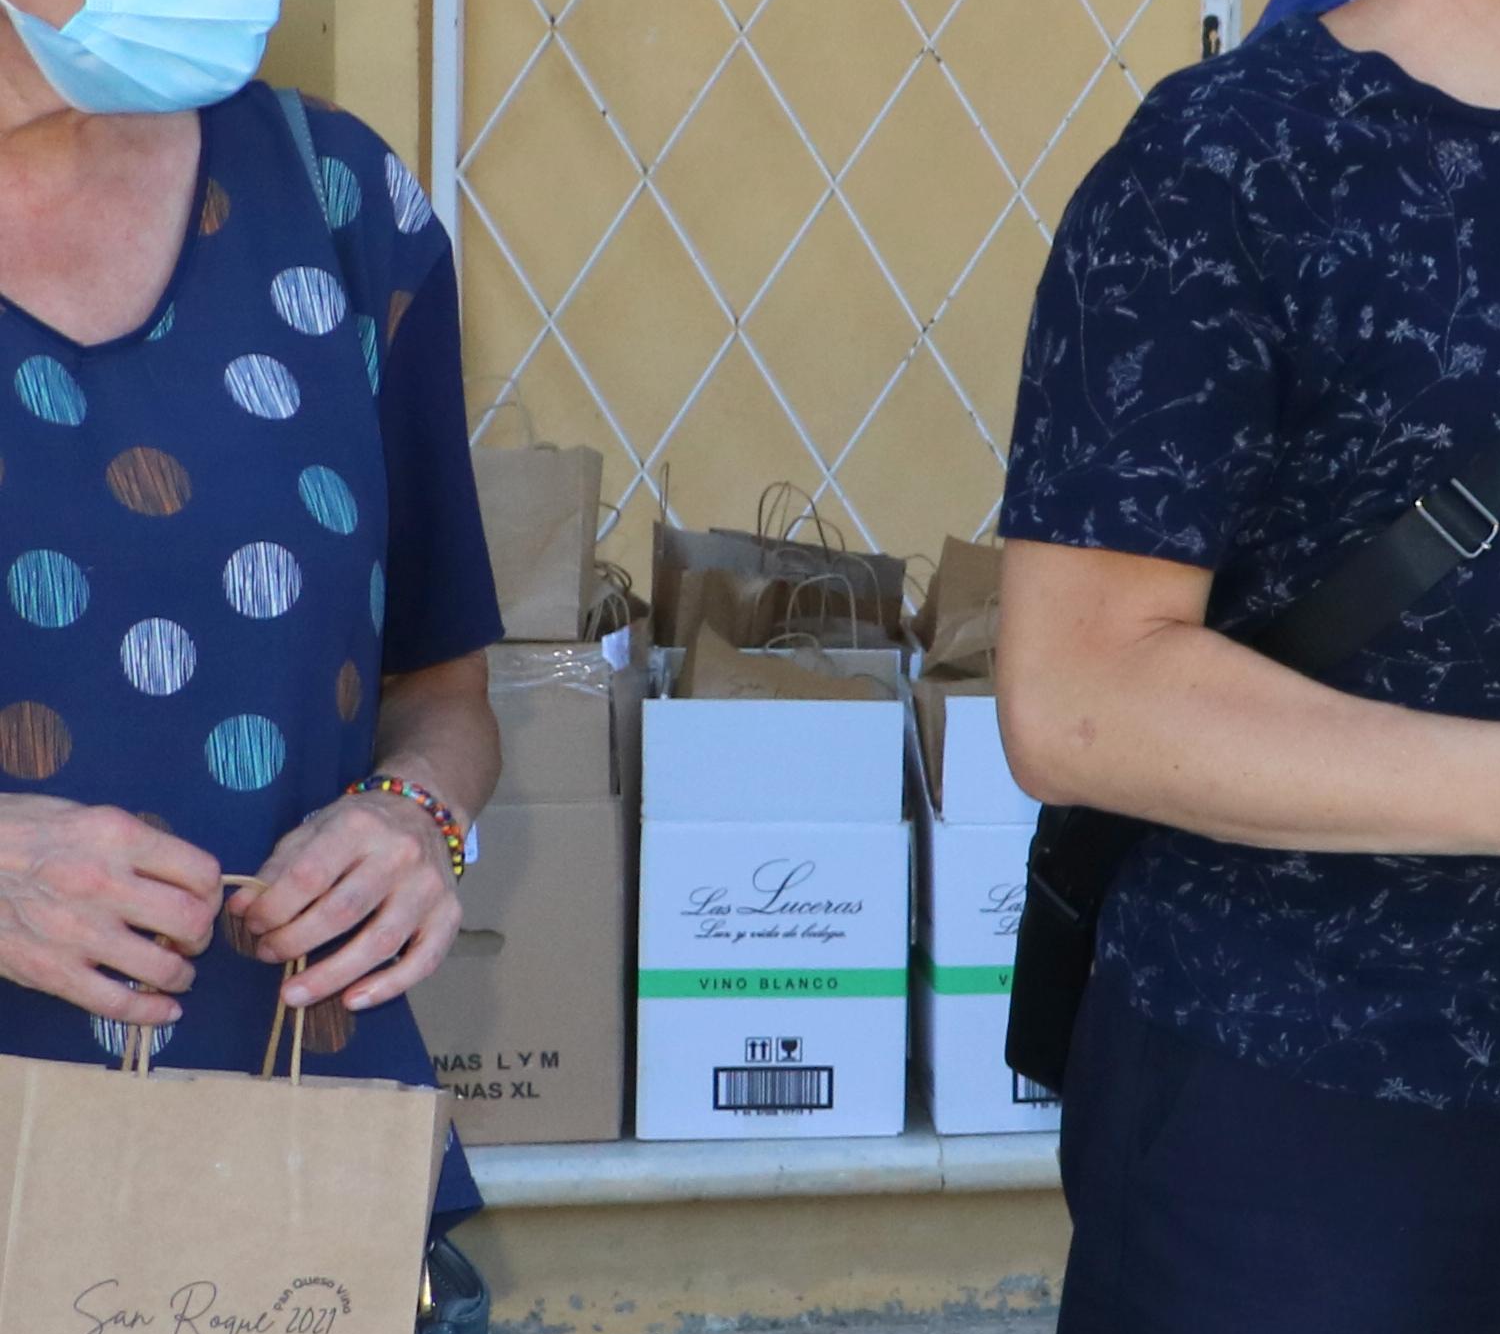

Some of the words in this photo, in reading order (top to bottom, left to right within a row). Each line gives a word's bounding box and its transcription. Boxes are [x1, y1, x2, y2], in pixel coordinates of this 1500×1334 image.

[680, 885, 732, 917] Las
[737, 858, 864, 916] Luceras
[699, 977, 749, 991] VINO
[759, 976, 840, 990] BLANCO
[433, 1054, 483, 1073] NAS
[497, 1052, 511, 1071] L
[518, 1051, 532, 1068] Y
[540, 1050, 560, 1069] M
[446, 1081, 503, 1100] NAS
[510, 1080, 541, 1100] XL
[273, 1288, 294, 1312] Pan
[292, 1276, 336, 1291] Queso
[336, 1284, 352, 1315] Vino
